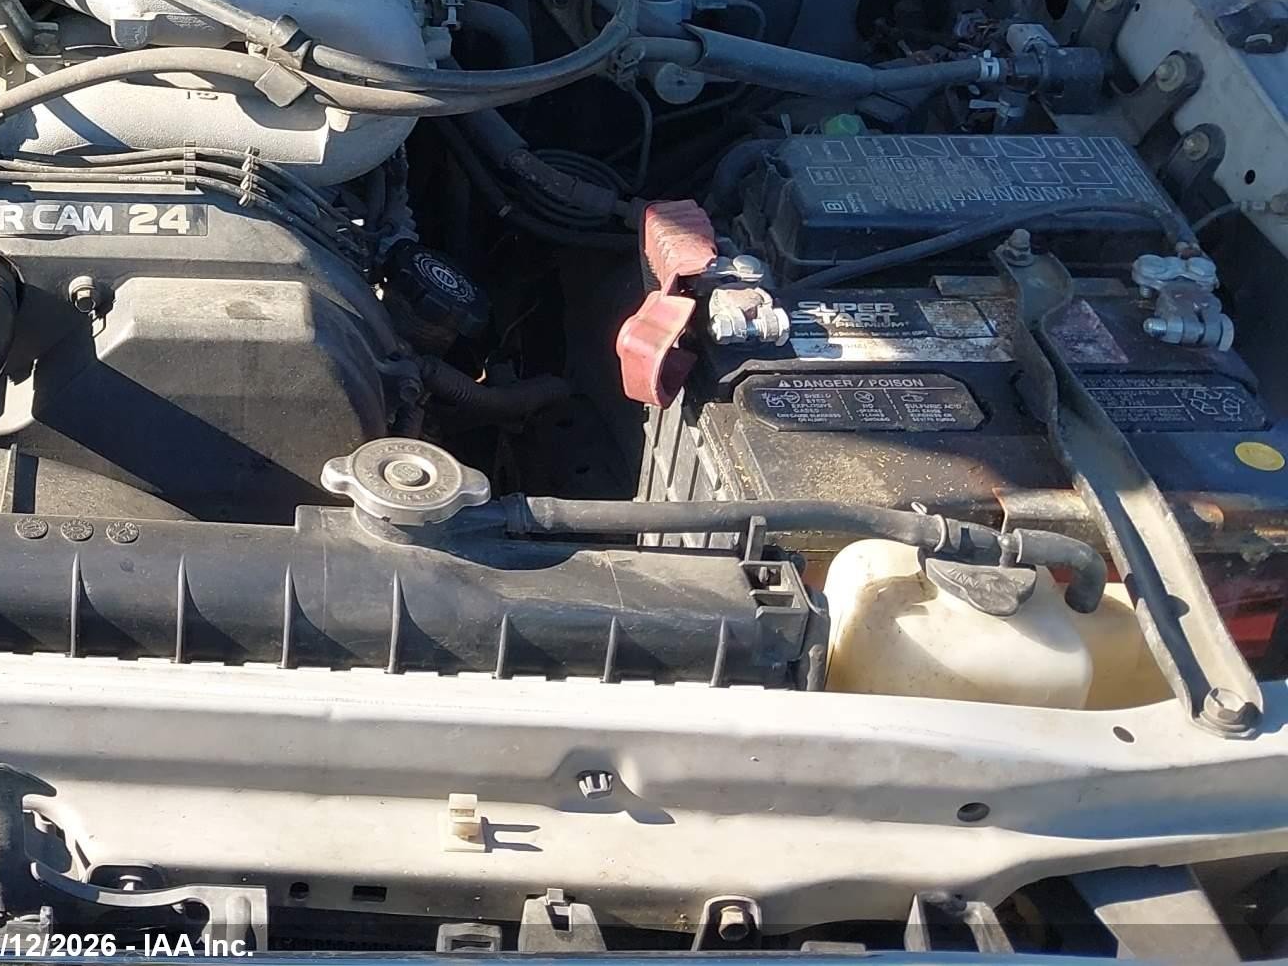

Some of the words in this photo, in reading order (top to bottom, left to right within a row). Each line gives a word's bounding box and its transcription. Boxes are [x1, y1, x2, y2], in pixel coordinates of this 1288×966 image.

[32, 204, 112, 231] CAM
[128, 204, 191, 234] 24
[797, 301, 896, 313] SUPER
[791, 310, 900, 325] START
[792, 379, 853, 388] DANGER
[868, 378, 924, 387] POISON
